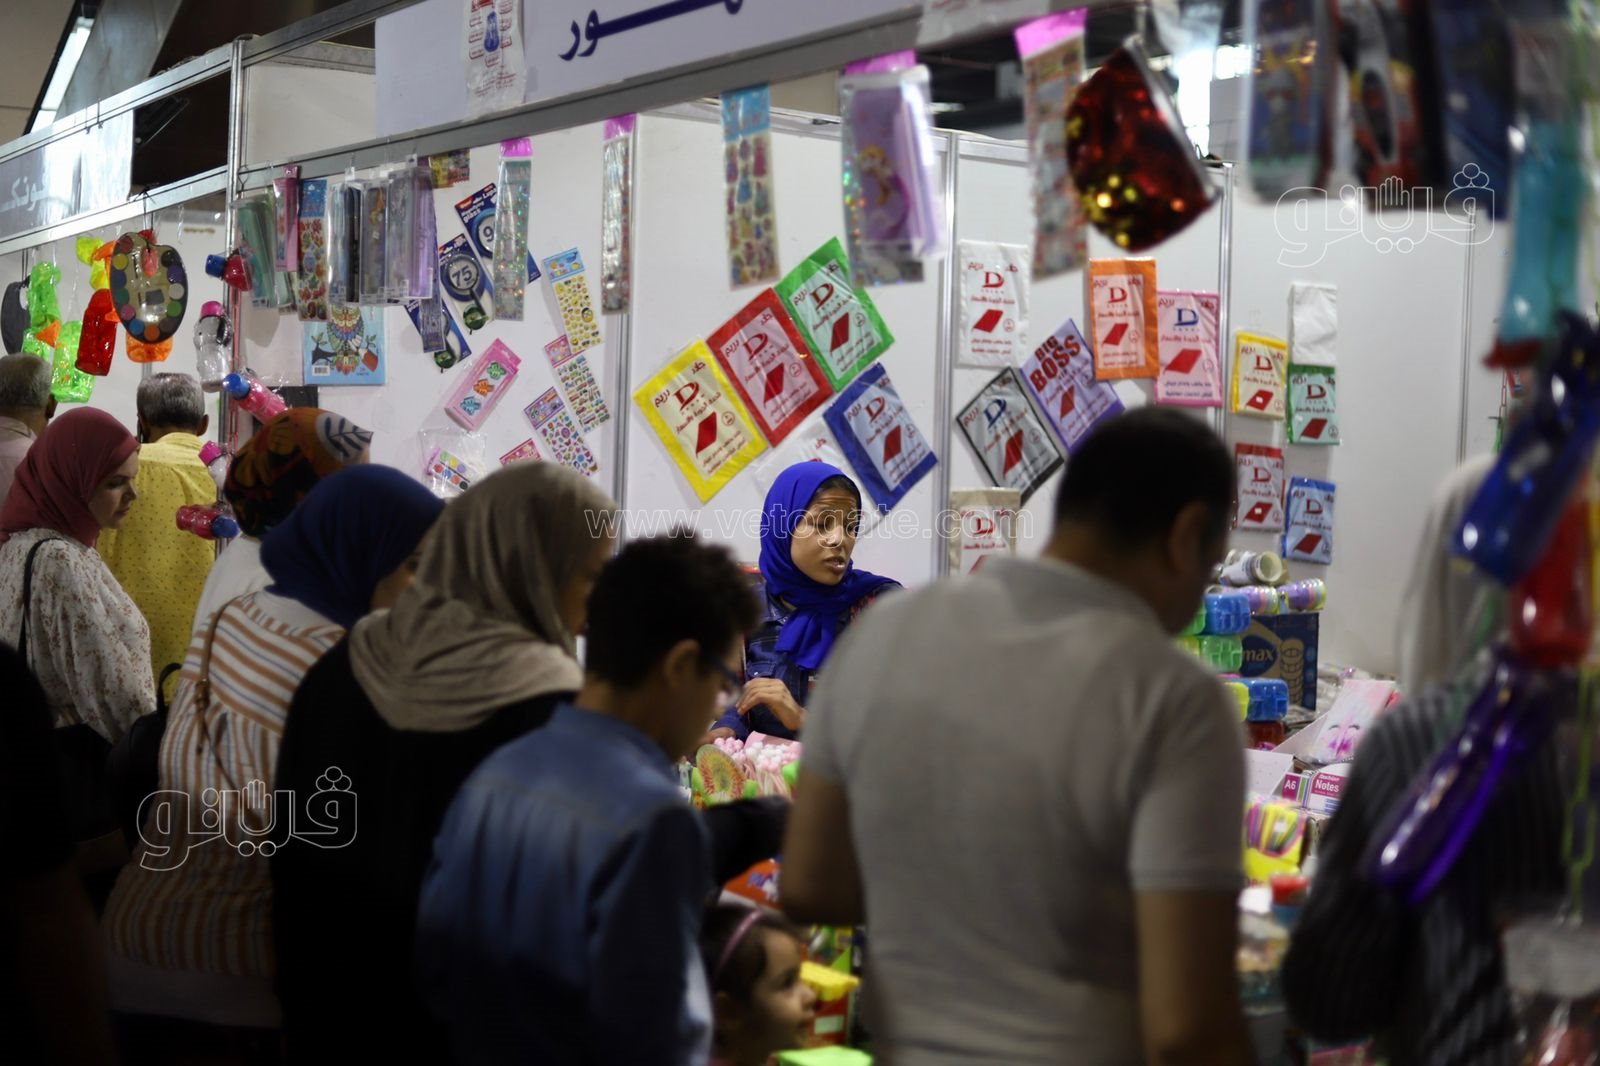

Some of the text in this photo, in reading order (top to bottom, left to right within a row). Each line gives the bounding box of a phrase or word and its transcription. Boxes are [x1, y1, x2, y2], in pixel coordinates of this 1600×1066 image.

[451, 265, 474, 287] 75
[982, 271, 1005, 289] D
[810, 282, 834, 312] D
[1108, 286, 1128, 305] D
[1174, 308, 1199, 327] D
[743, 332, 769, 363] D
[1034, 335, 1059, 361] BIG
[1029, 334, 1082, 393] BOSS
[654, 389, 671, 409] دريم
[674, 381, 700, 412] D
[1306, 384, 1327, 400] D
[865, 396, 887, 424] D
[983, 398, 1007, 430] D
[1284, 777, 1297, 791] A6
[1314, 779, 1340, 794] Notes
